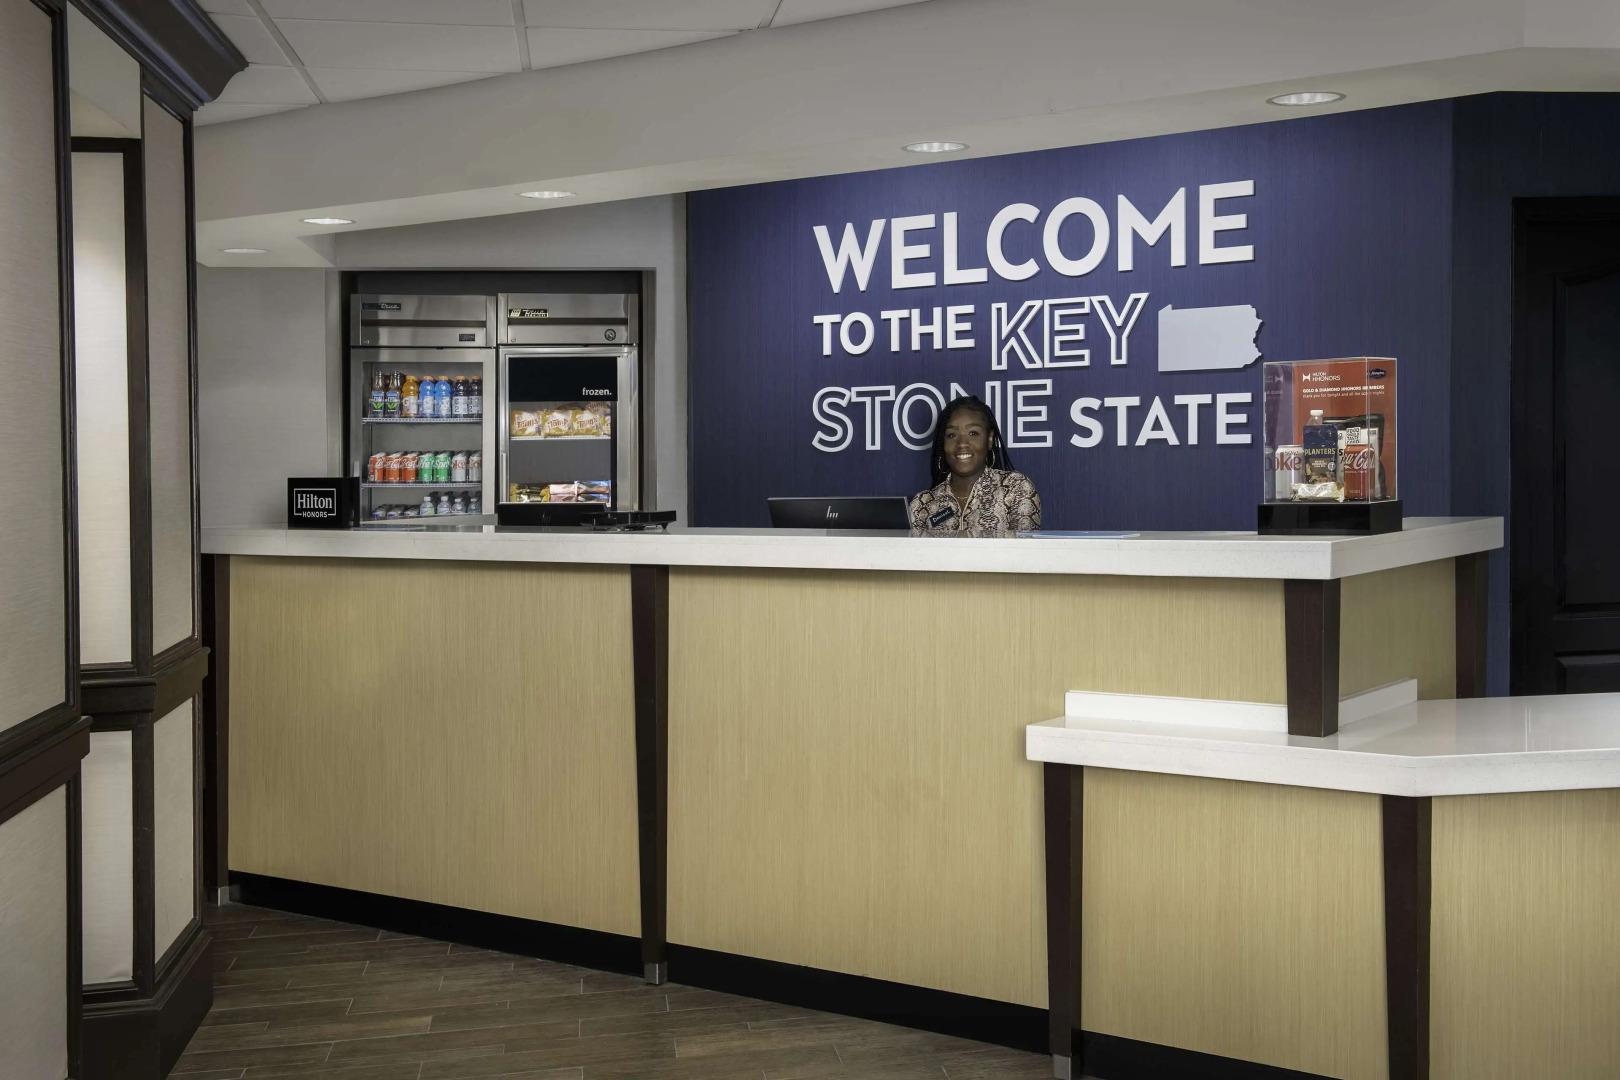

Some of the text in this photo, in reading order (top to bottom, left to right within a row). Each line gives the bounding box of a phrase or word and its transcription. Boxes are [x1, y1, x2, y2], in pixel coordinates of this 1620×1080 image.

[812, 179, 1255, 294] WELCOME
[813, 292, 1150, 371] TO THE KEY
[582, 387, 612, 396] frozen.
[1070, 392, 1253, 449] STATE
[1304, 448, 1336, 456] PLANTERS
[297, 494, 333, 508] Hilton
